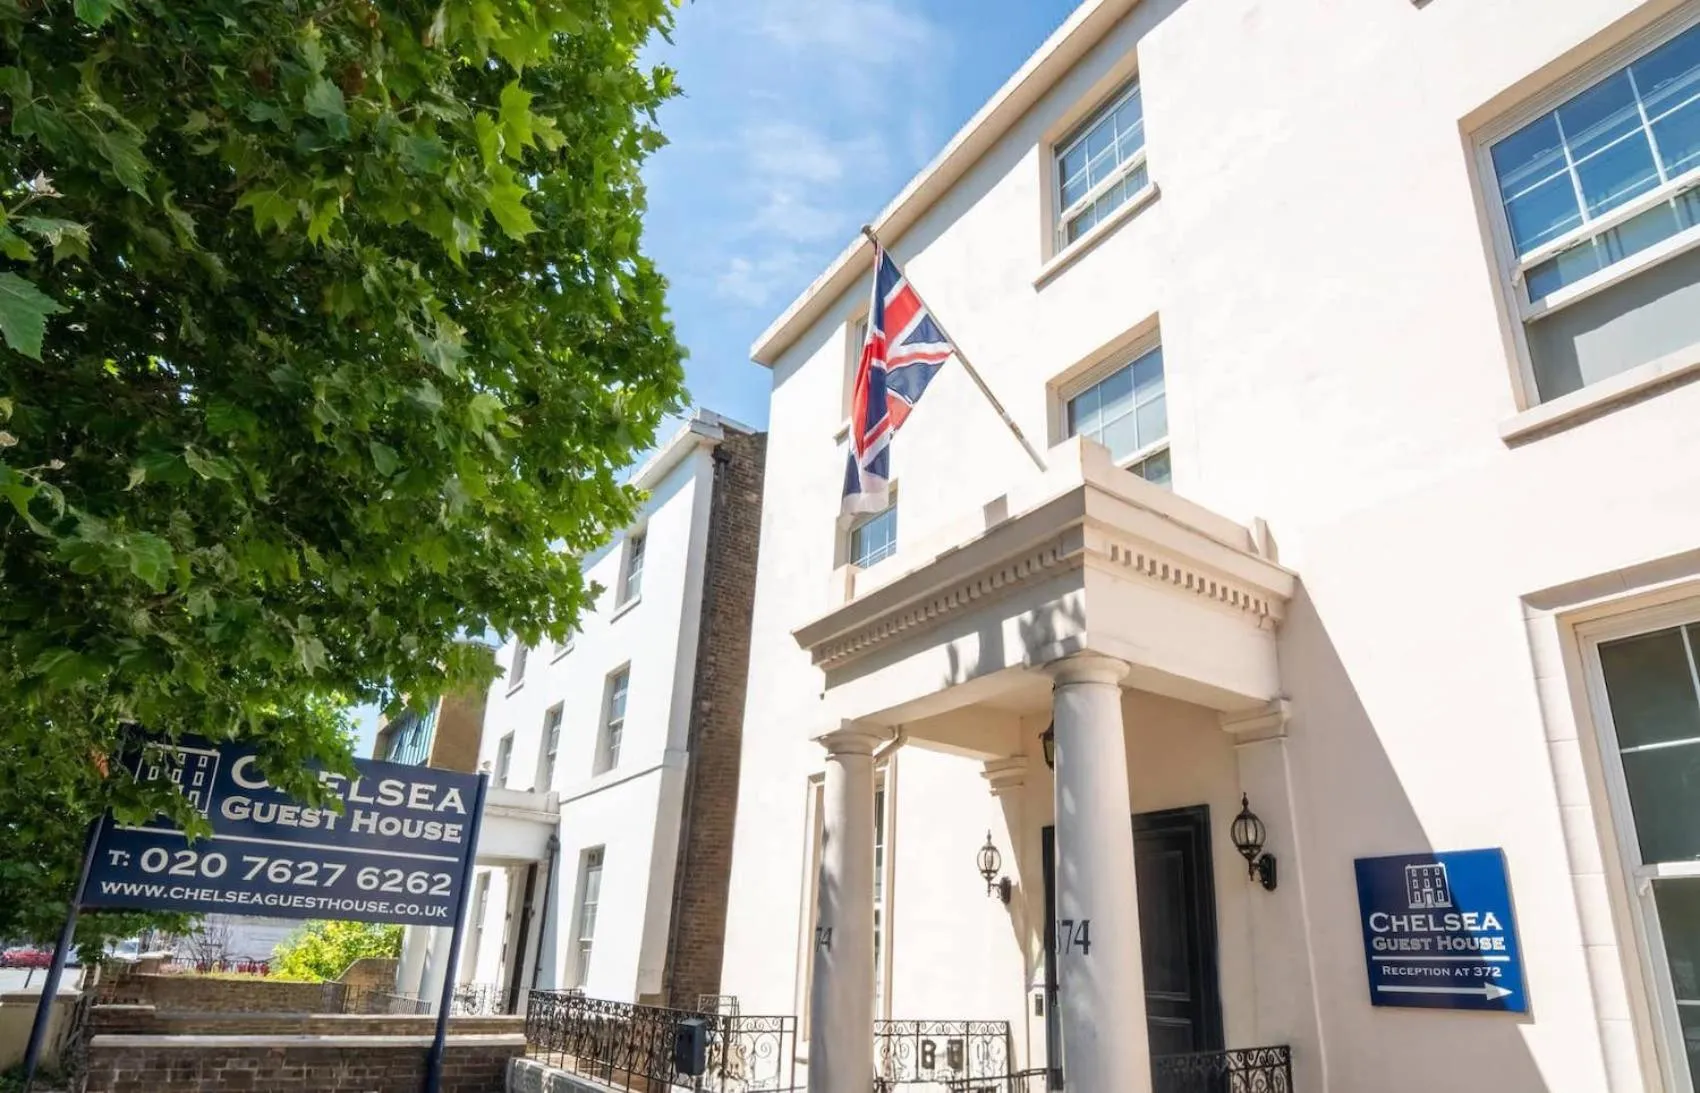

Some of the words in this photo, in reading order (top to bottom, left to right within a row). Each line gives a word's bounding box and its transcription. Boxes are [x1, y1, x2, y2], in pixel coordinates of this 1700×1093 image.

[231, 755, 466, 815] CELSEA
[221, 795, 341, 831] GUEST
[351, 809, 463, 844] HOUSE
[108, 849, 130, 866] T:
[140, 847, 227, 878] 020
[242, 855, 346, 887] 7627
[356, 867, 452, 896] 6262
[100, 880, 448, 918] WWW.CHELSEAGUESTHOUSE.CO.UK
[1056, 919, 1091, 955] 74
[1369, 912, 1503, 932] CHELSEA
[1372, 936, 1432, 951] GUEST
[1437, 935, 1506, 951] HOUSE
[1382, 966, 1450, 976] RECEPTION
[1454, 967, 1470, 976] AT
[1474, 966, 1502, 977] 372
